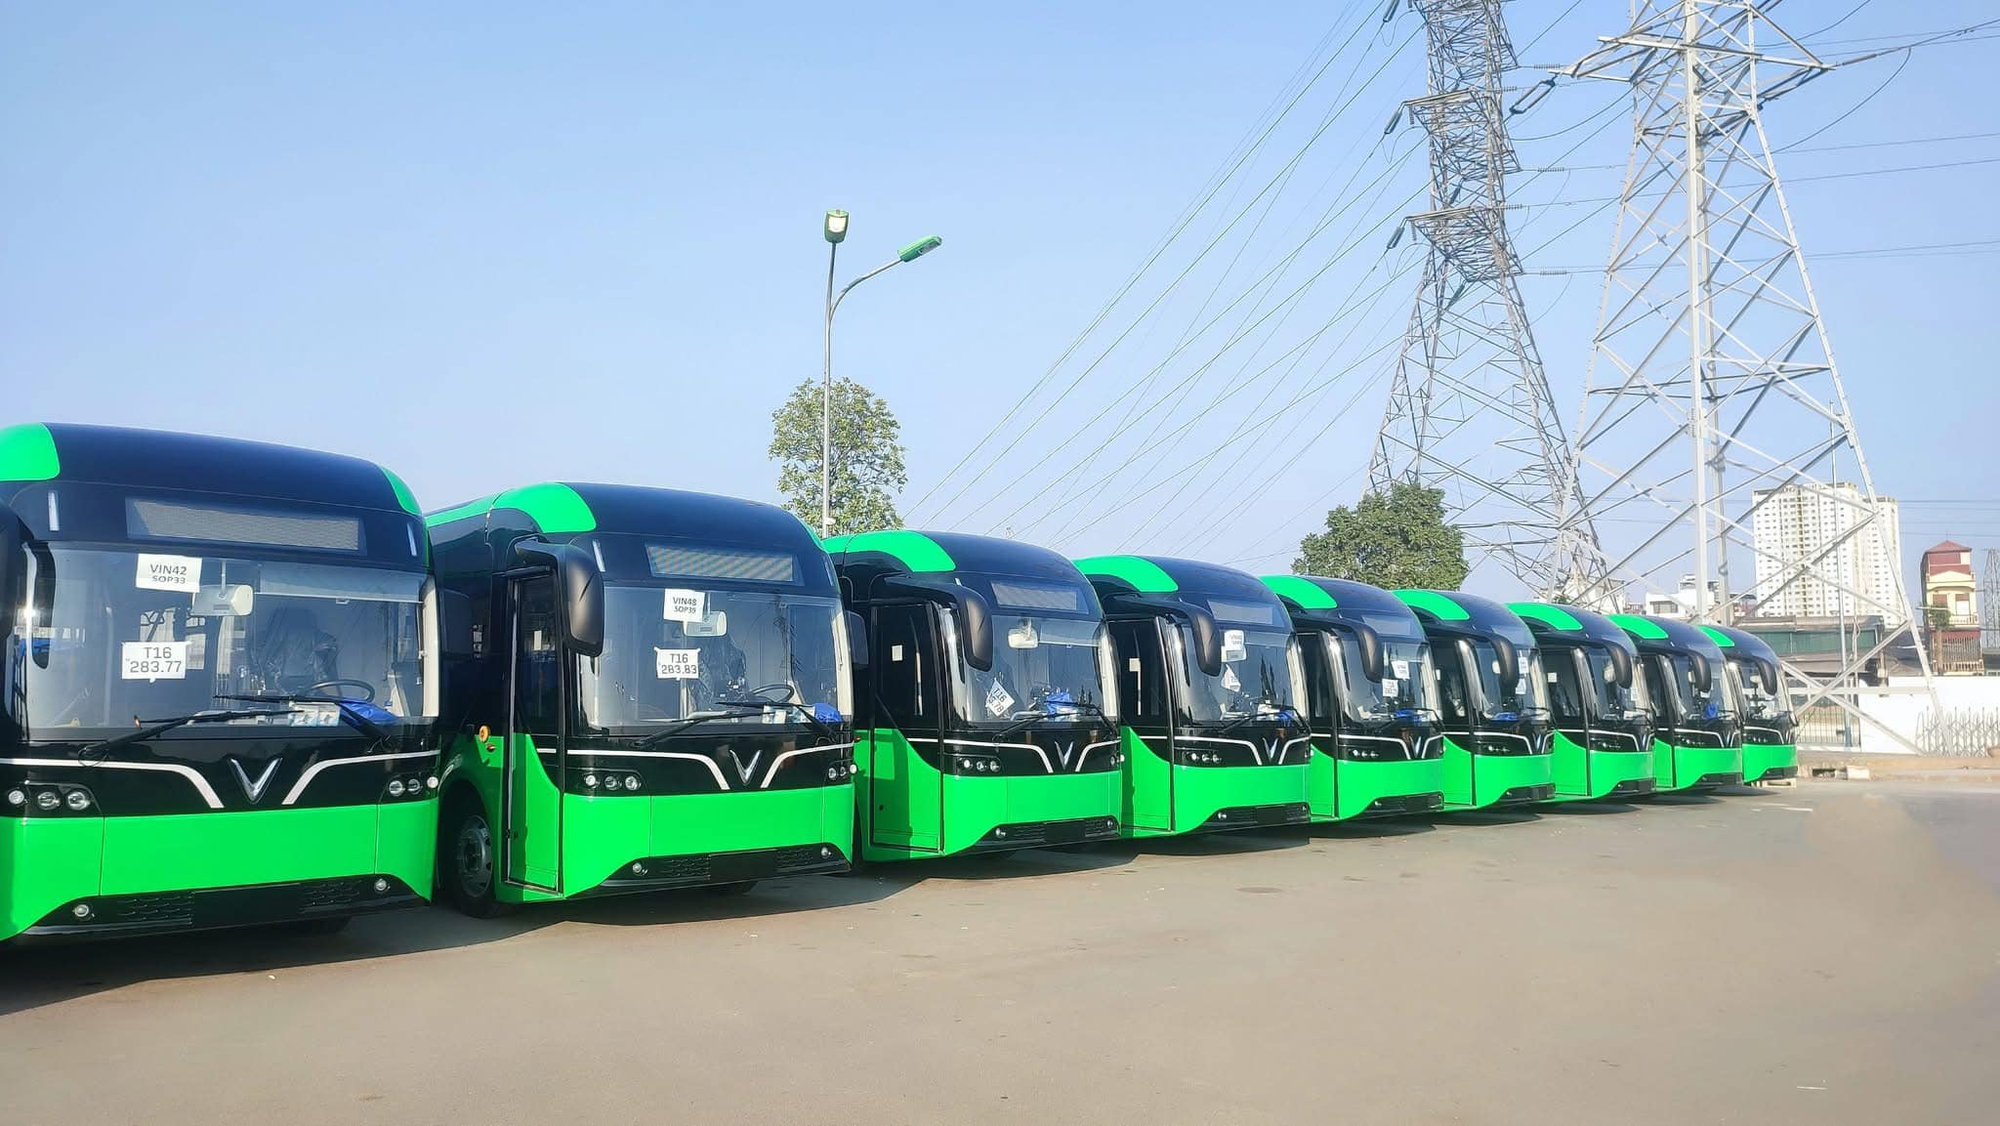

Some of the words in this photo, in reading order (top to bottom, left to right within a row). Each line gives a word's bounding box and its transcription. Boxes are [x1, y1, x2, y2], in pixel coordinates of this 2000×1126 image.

[149, 563, 187, 575] VIN42
[672, 596, 697, 606] VIN48
[144, 646, 172, 659] T16
[669, 653, 689, 663] T16
[129, 660, 182, 673] 283.77
[661, 664, 697, 674] 283.83
